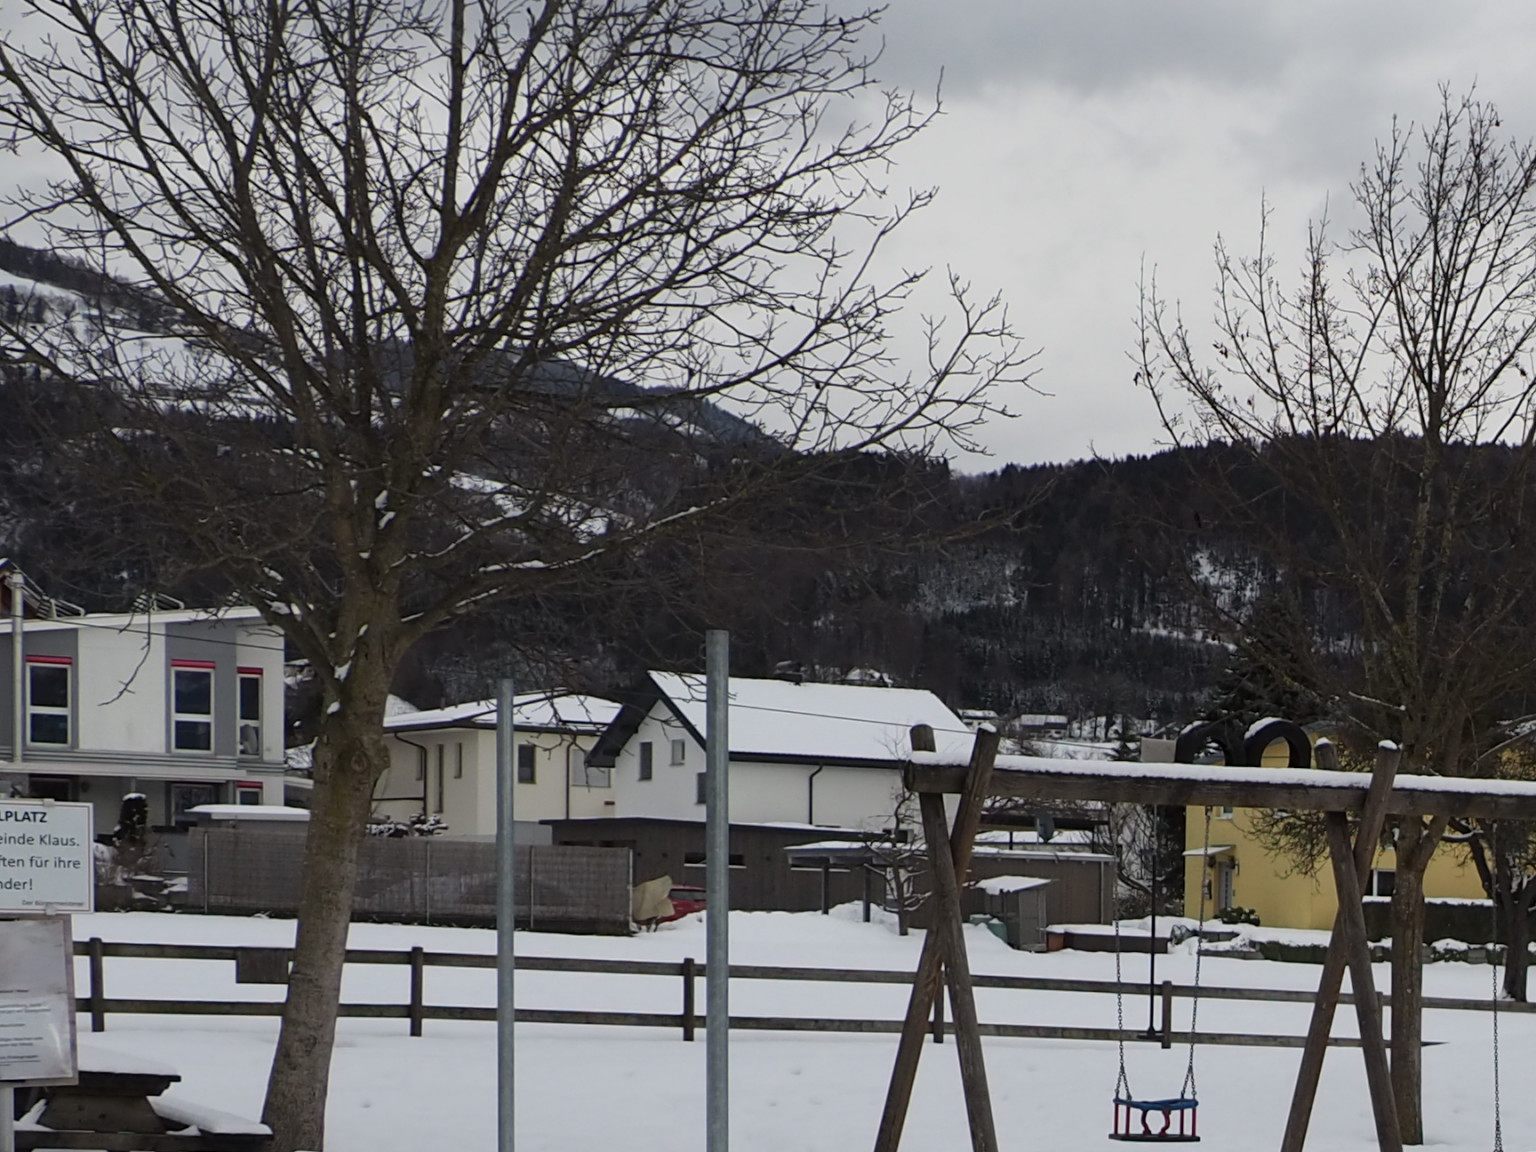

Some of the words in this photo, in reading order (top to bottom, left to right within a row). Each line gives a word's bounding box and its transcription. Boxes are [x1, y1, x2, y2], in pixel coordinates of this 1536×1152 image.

[39, 834, 80, 847] Klaus.
[30, 855, 50, 868] für
[54, 856, 81, 869] ihre
